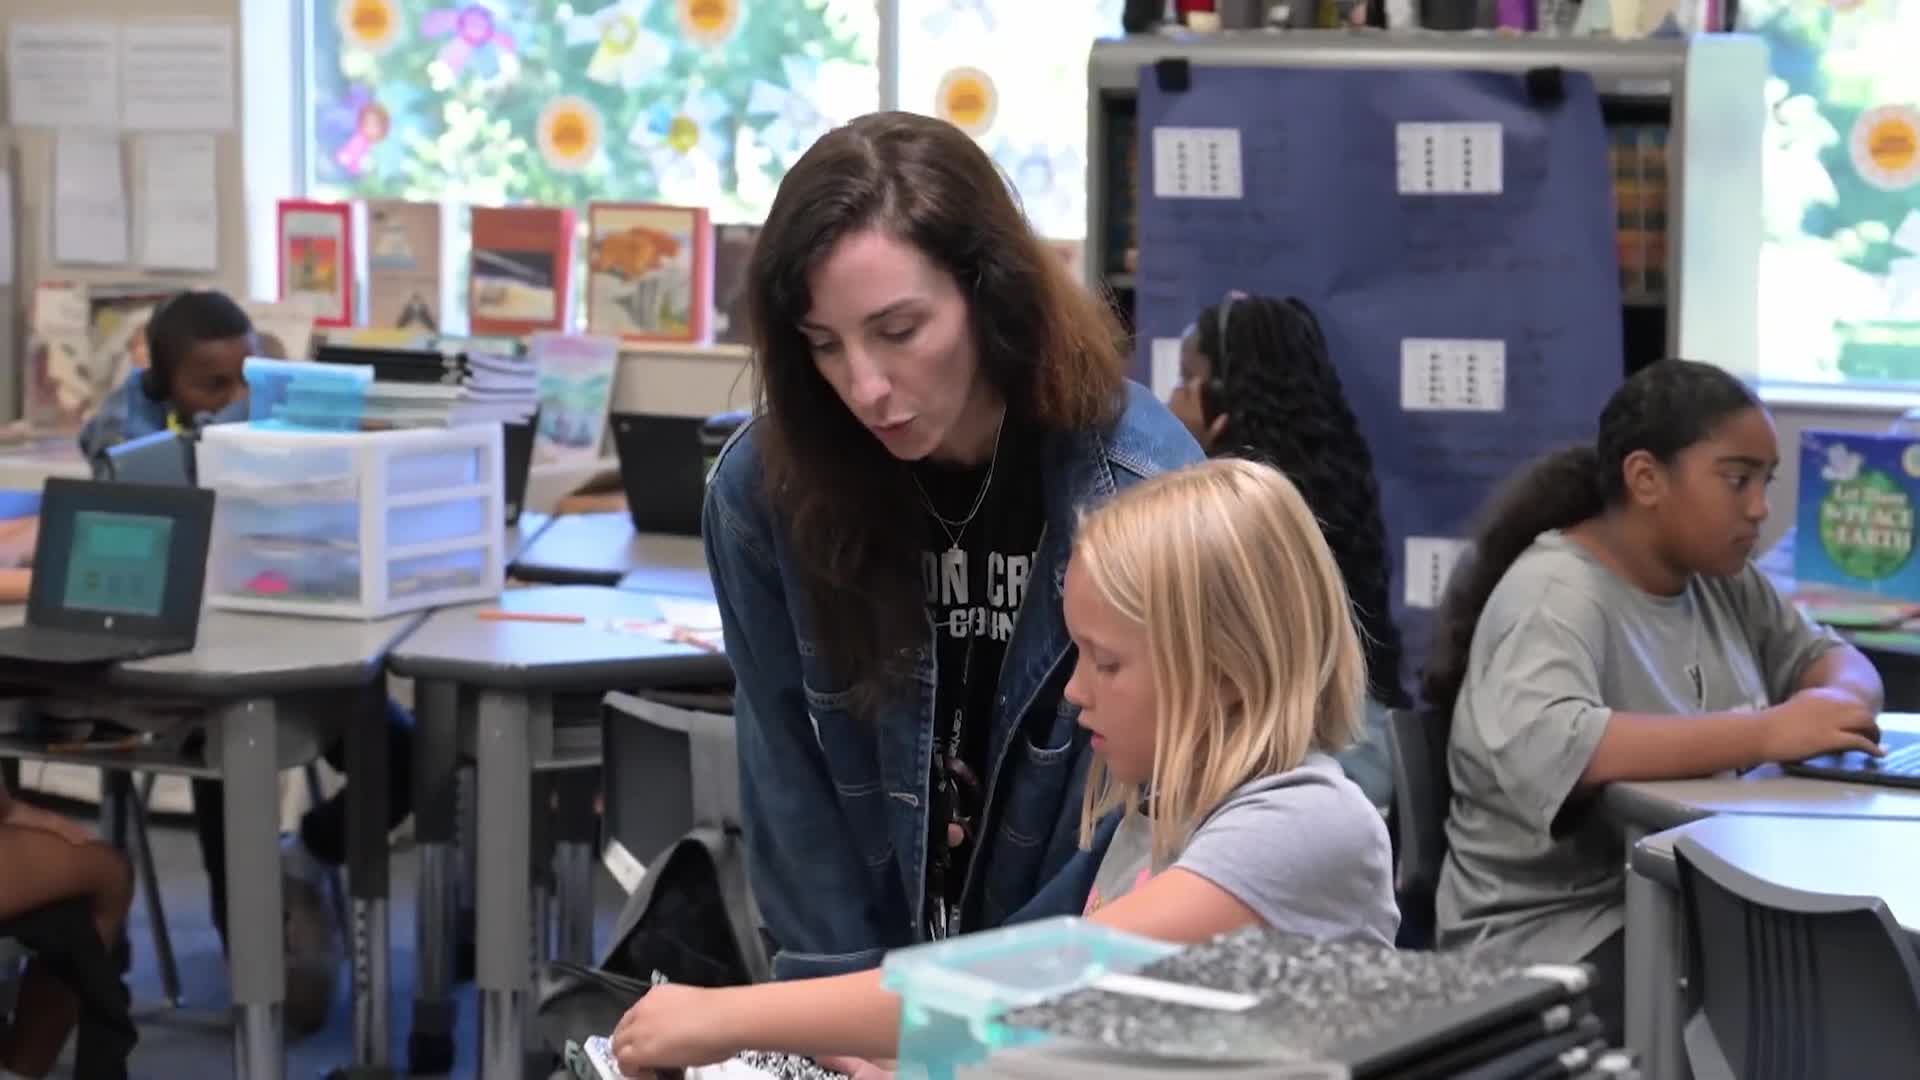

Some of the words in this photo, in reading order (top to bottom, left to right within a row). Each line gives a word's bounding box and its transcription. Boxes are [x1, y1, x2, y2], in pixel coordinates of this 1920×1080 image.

[1844, 504, 1913, 529] PEACE
[1836, 526, 1911, 552] EARTH
[987, 551, 1038, 608] CR
